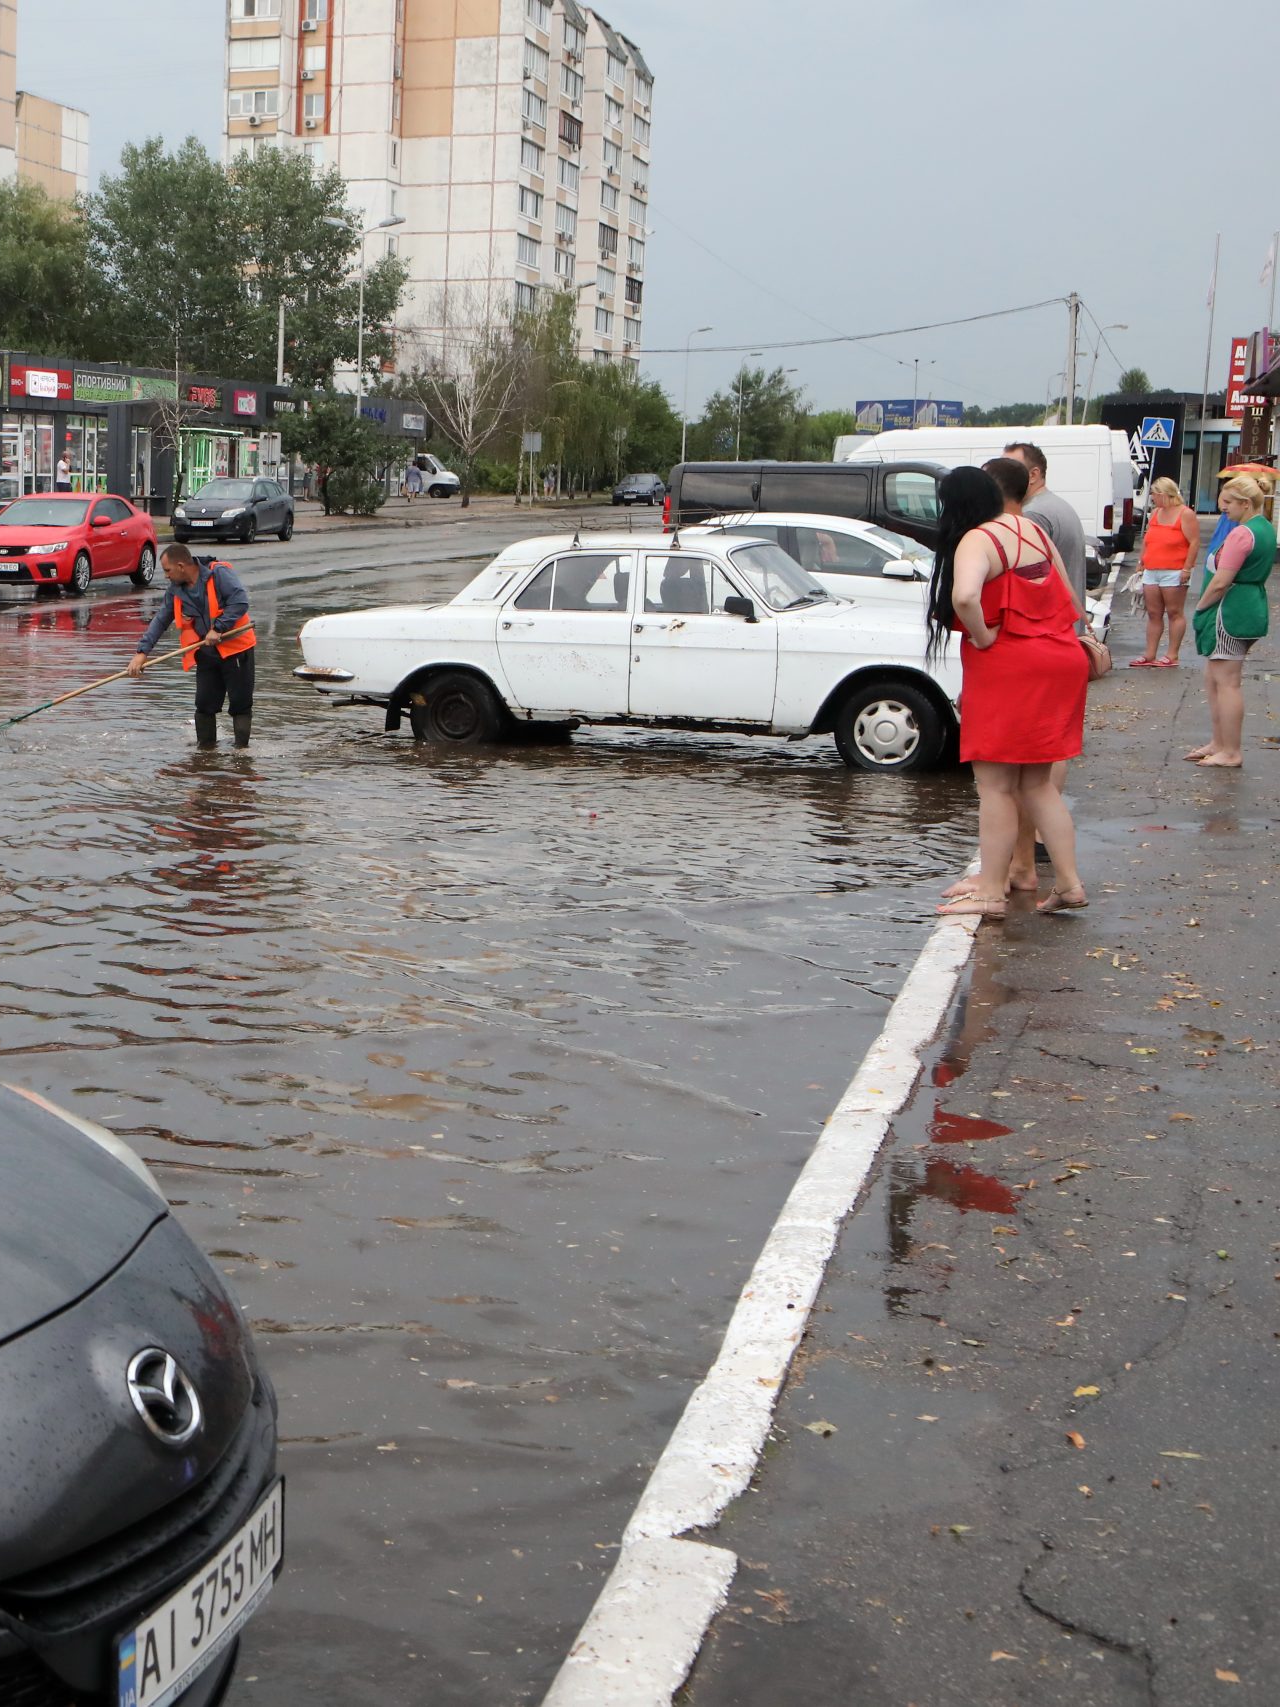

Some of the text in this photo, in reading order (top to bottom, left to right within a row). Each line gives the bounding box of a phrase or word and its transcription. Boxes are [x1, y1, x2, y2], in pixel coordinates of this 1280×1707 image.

[76, 374, 127, 391] СПОРТИВНИЙ
[140, 1609, 176, 1699] AI
[191, 1540, 245, 1648] 3755
[249, 1500, 276, 1586] MH
